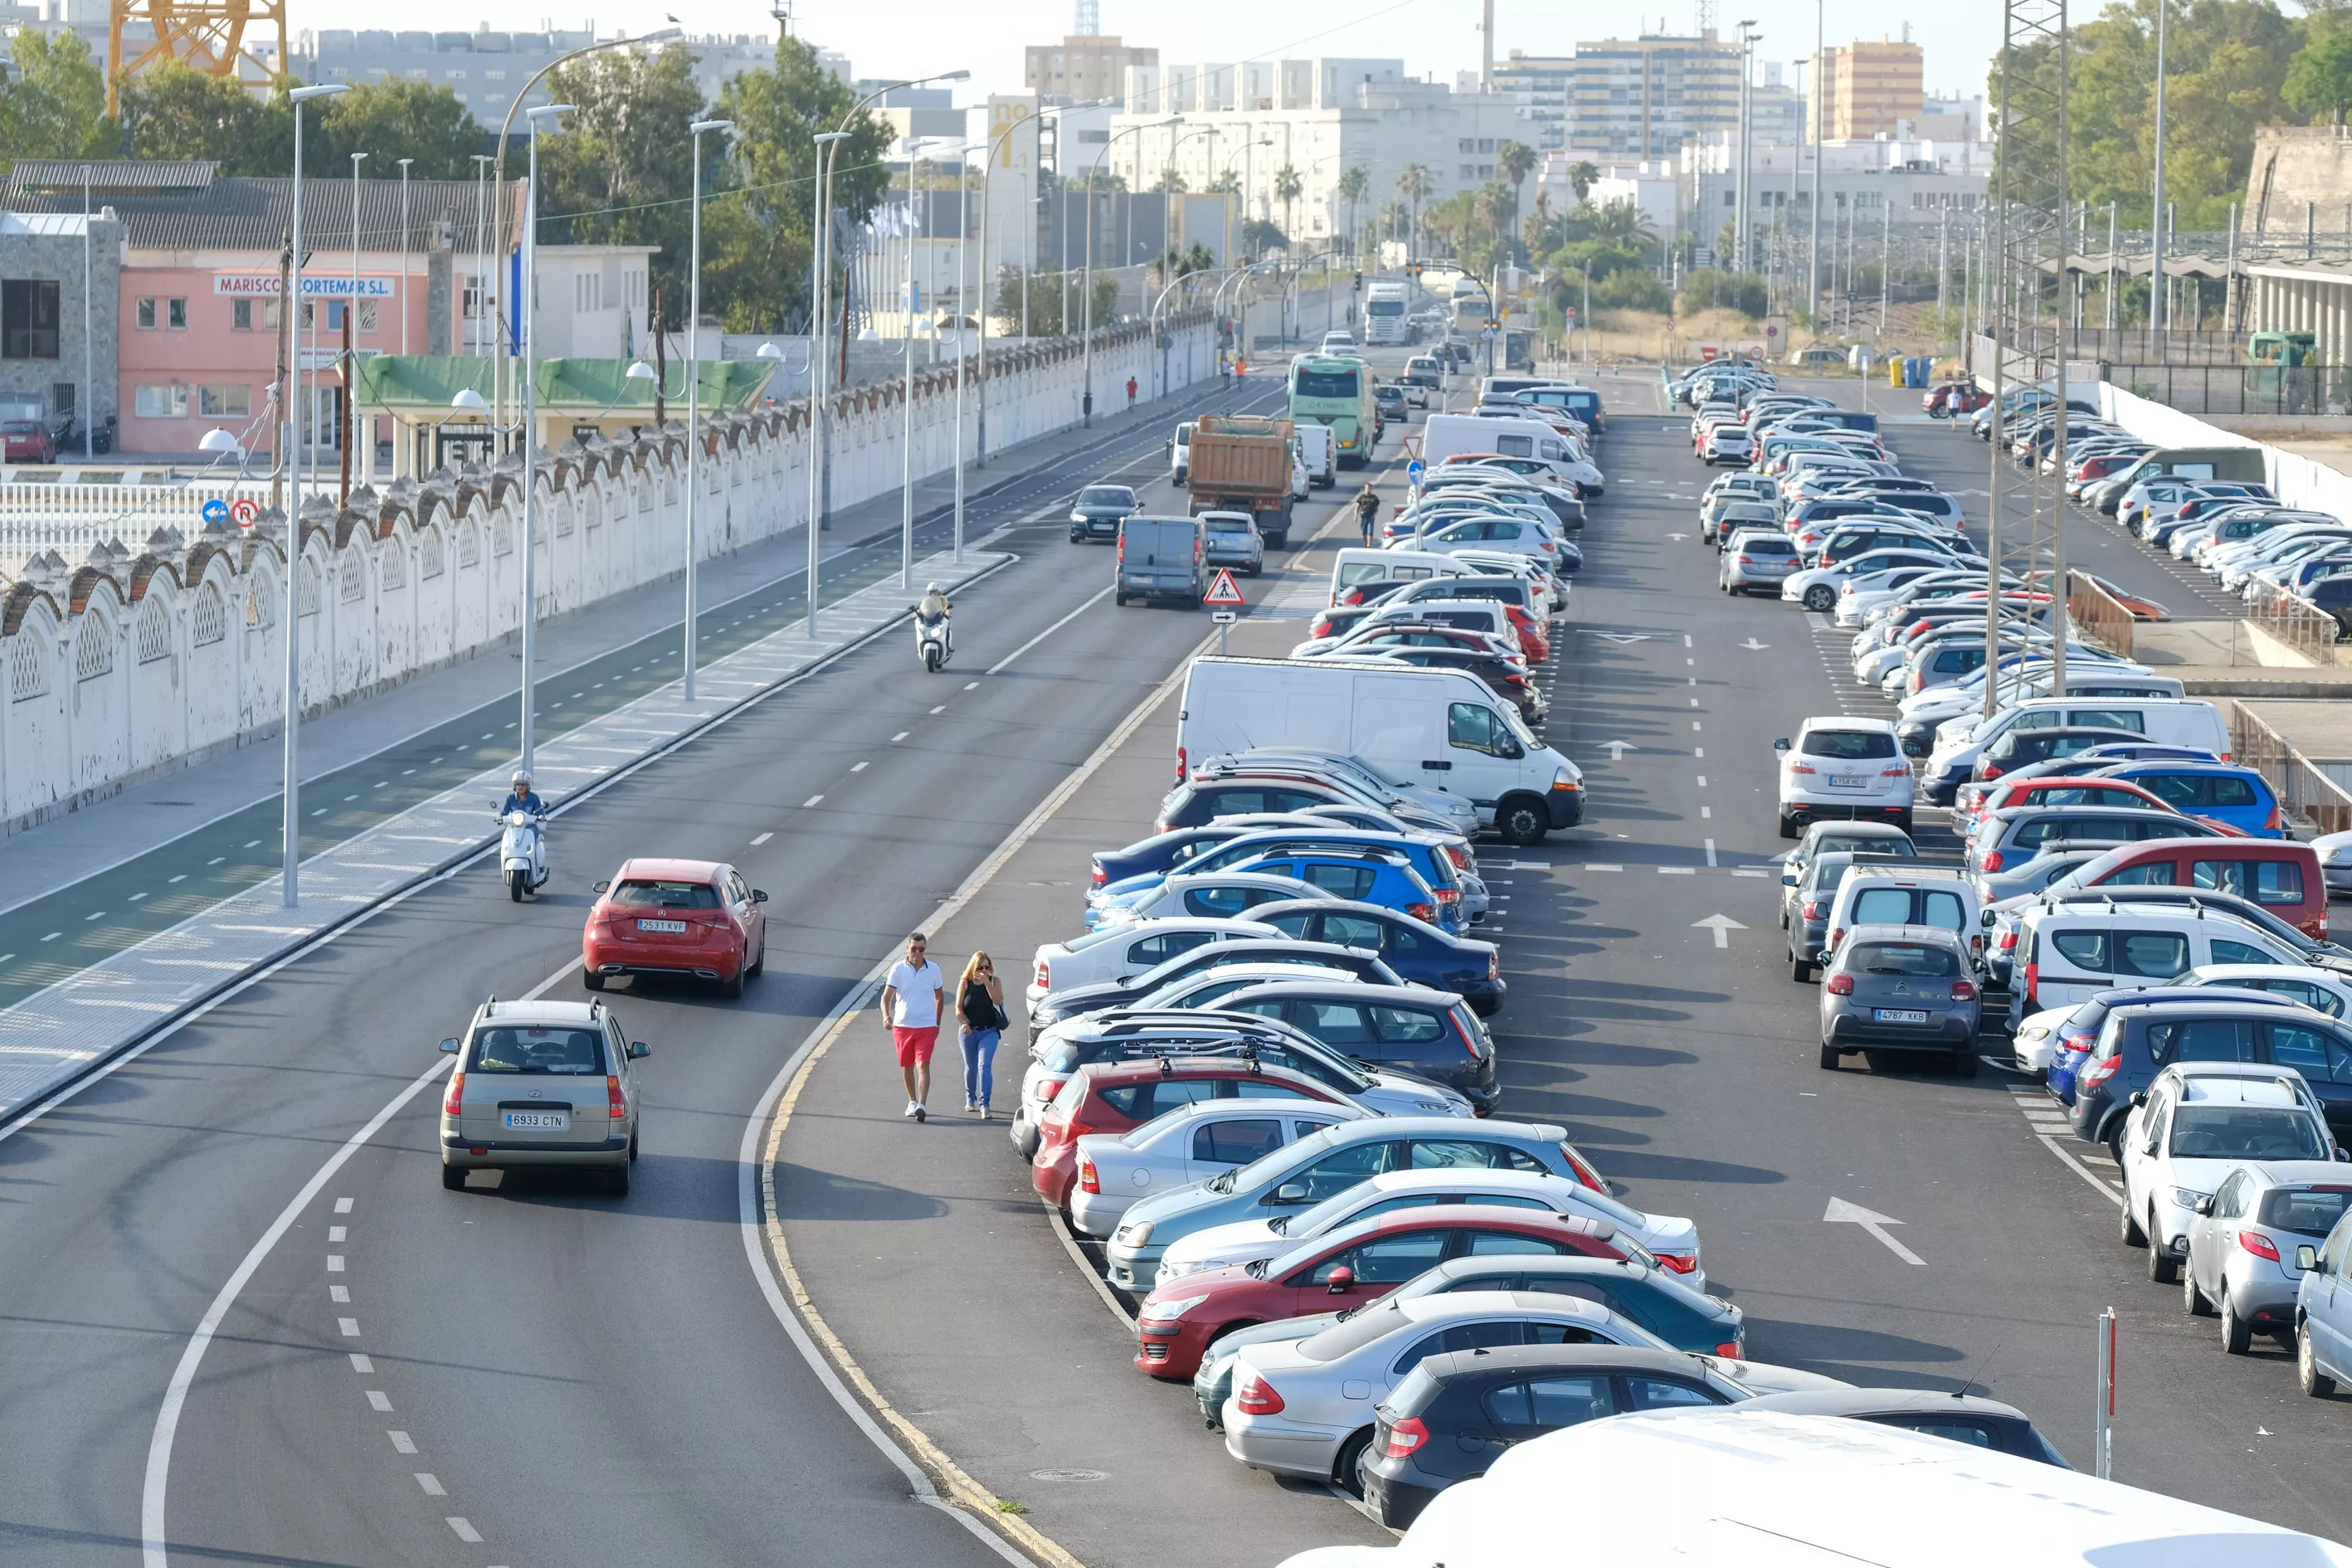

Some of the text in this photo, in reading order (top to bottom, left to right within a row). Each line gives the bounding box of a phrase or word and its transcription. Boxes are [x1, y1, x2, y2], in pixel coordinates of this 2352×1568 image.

[996, 103, 1029, 120] no
[221, 278, 387, 294] MARISCO ORTEMAR S.L.
[643, 921, 684, 930] 2531 KVF
[1882, 1010, 1924, 1021] 4787 KKB
[514, 1115, 562, 1127] 6933 CTN
